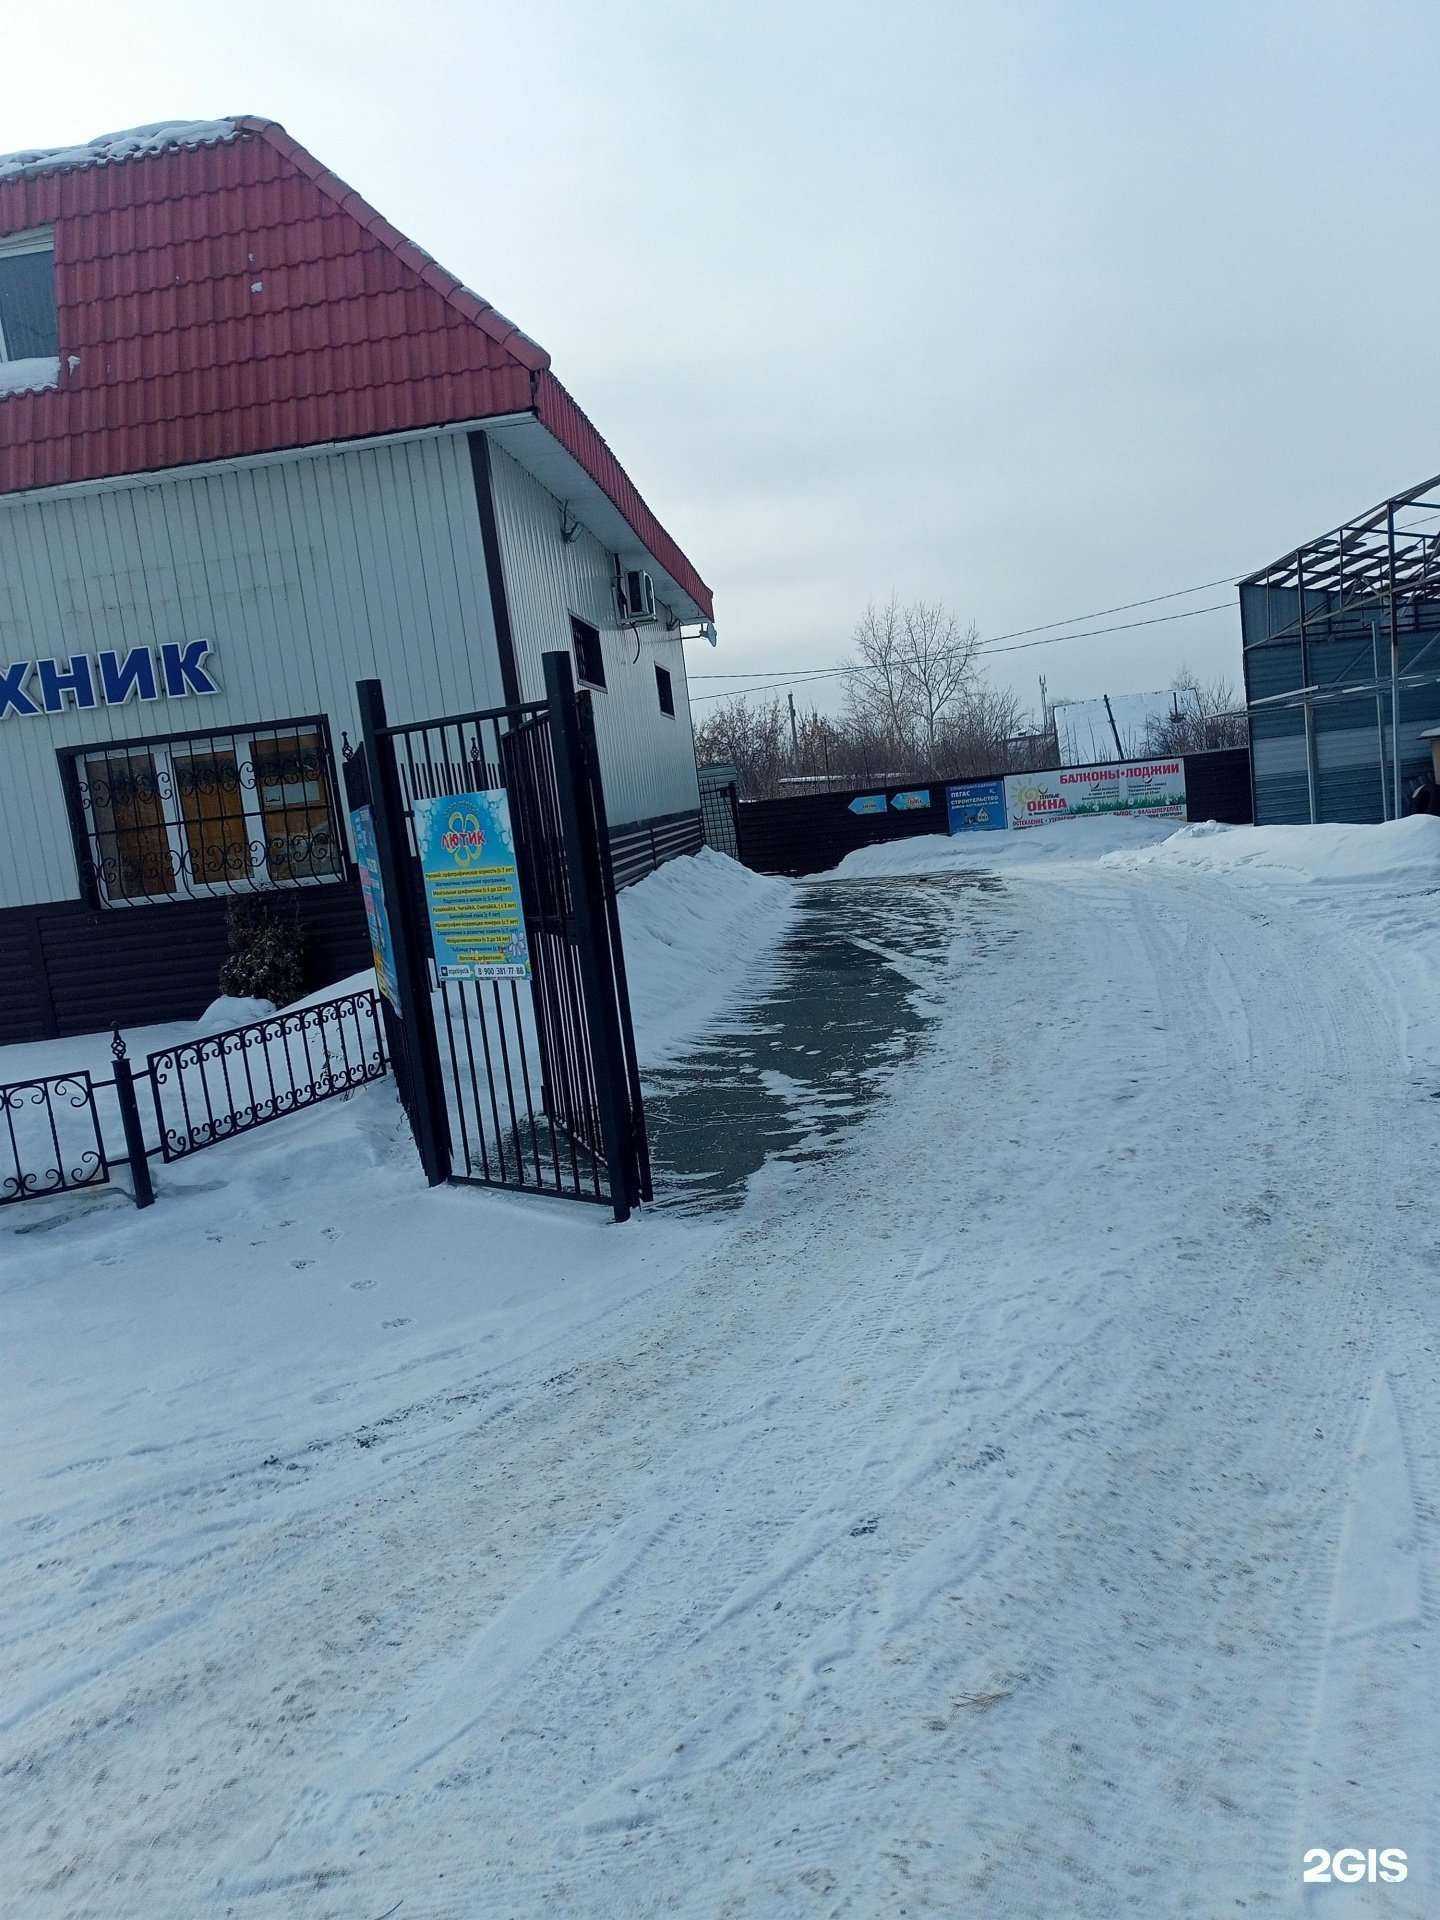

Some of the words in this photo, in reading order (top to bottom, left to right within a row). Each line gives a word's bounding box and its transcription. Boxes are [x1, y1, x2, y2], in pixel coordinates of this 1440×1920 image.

[1125, 763, 1180, 780] ЛОДЖИИ
[951, 790, 970, 798] ПЕГАС
[951, 795, 999, 805] СТРОИТЕЛЬСТВО
[1027, 797, 1068, 812] ОКНА
